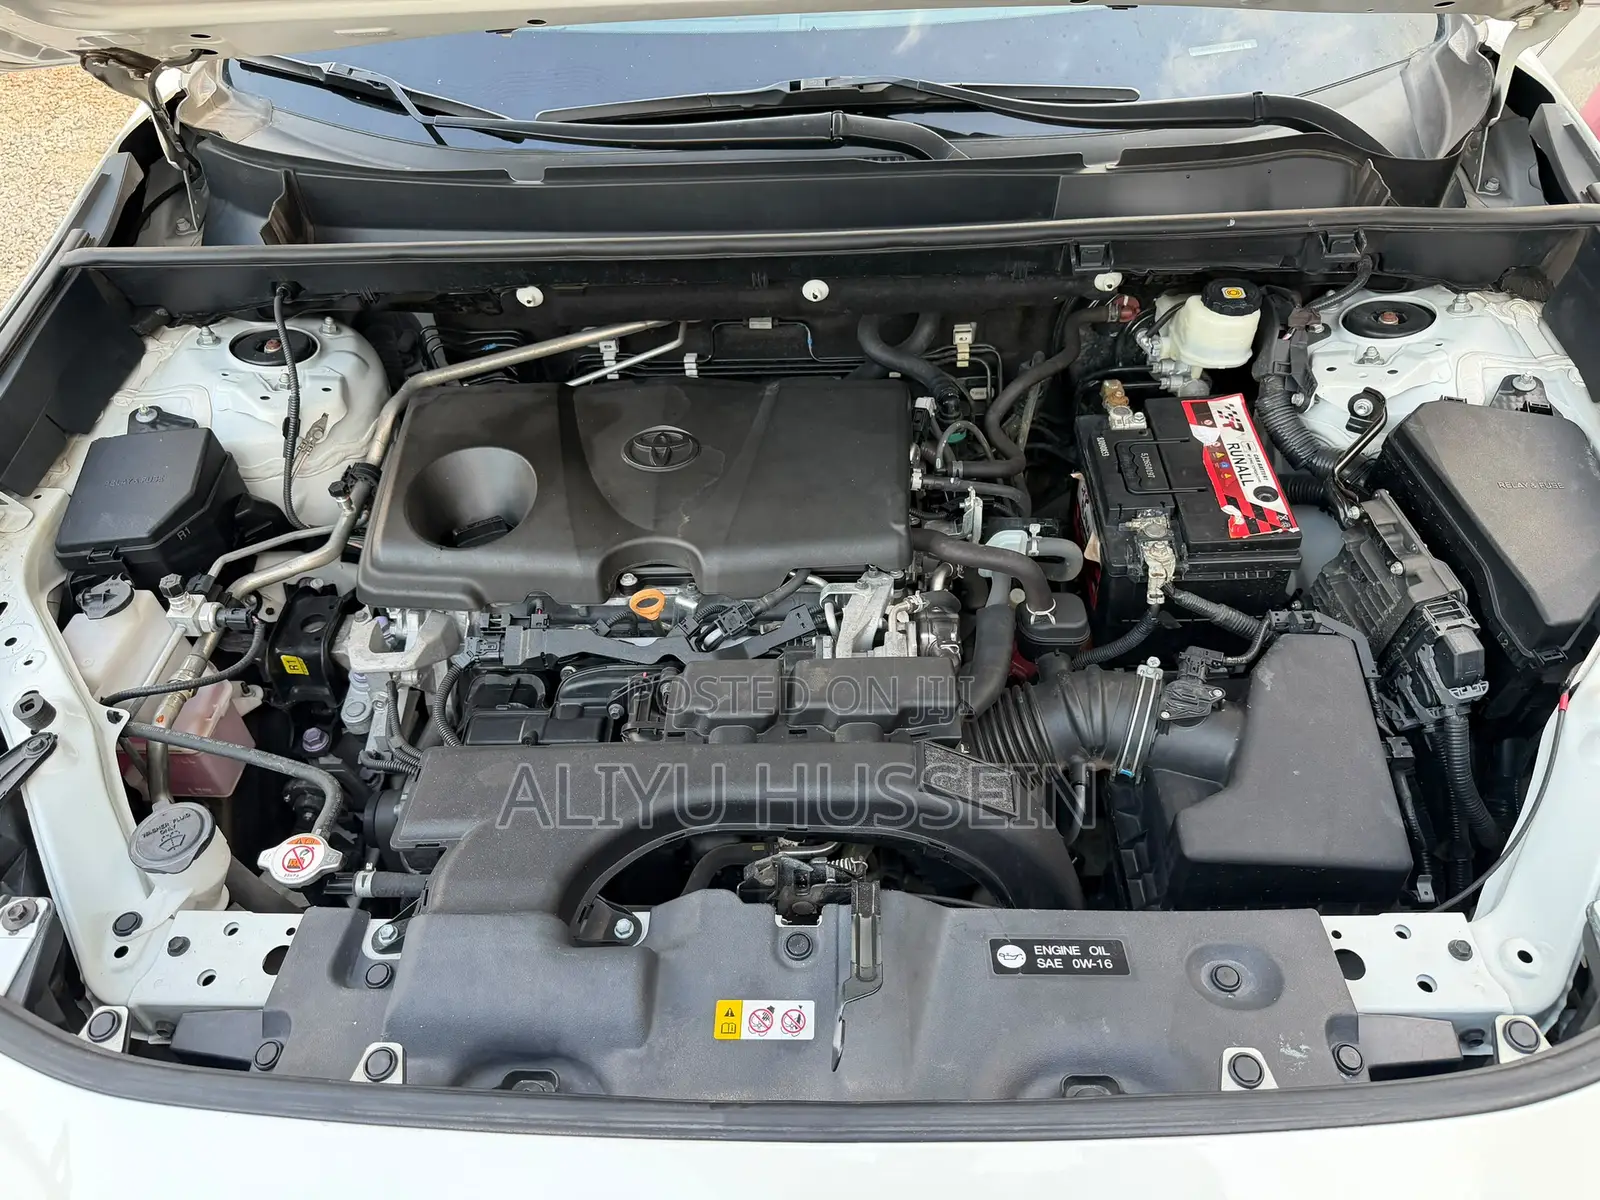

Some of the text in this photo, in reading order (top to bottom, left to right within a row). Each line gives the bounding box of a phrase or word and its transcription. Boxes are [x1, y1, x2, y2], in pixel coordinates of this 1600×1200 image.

[1226, 442, 1254, 487] RUNALL
[1497, 481, 1528, 490] RELAY
[1538, 481, 1565, 490] FUSE
[176, 526, 191, 541] R1
[287, 660, 300, 671] R1
[1033, 945, 1111, 956] ENGINE OIL
[1036, 958, 1113, 969] SAE 0W-16
